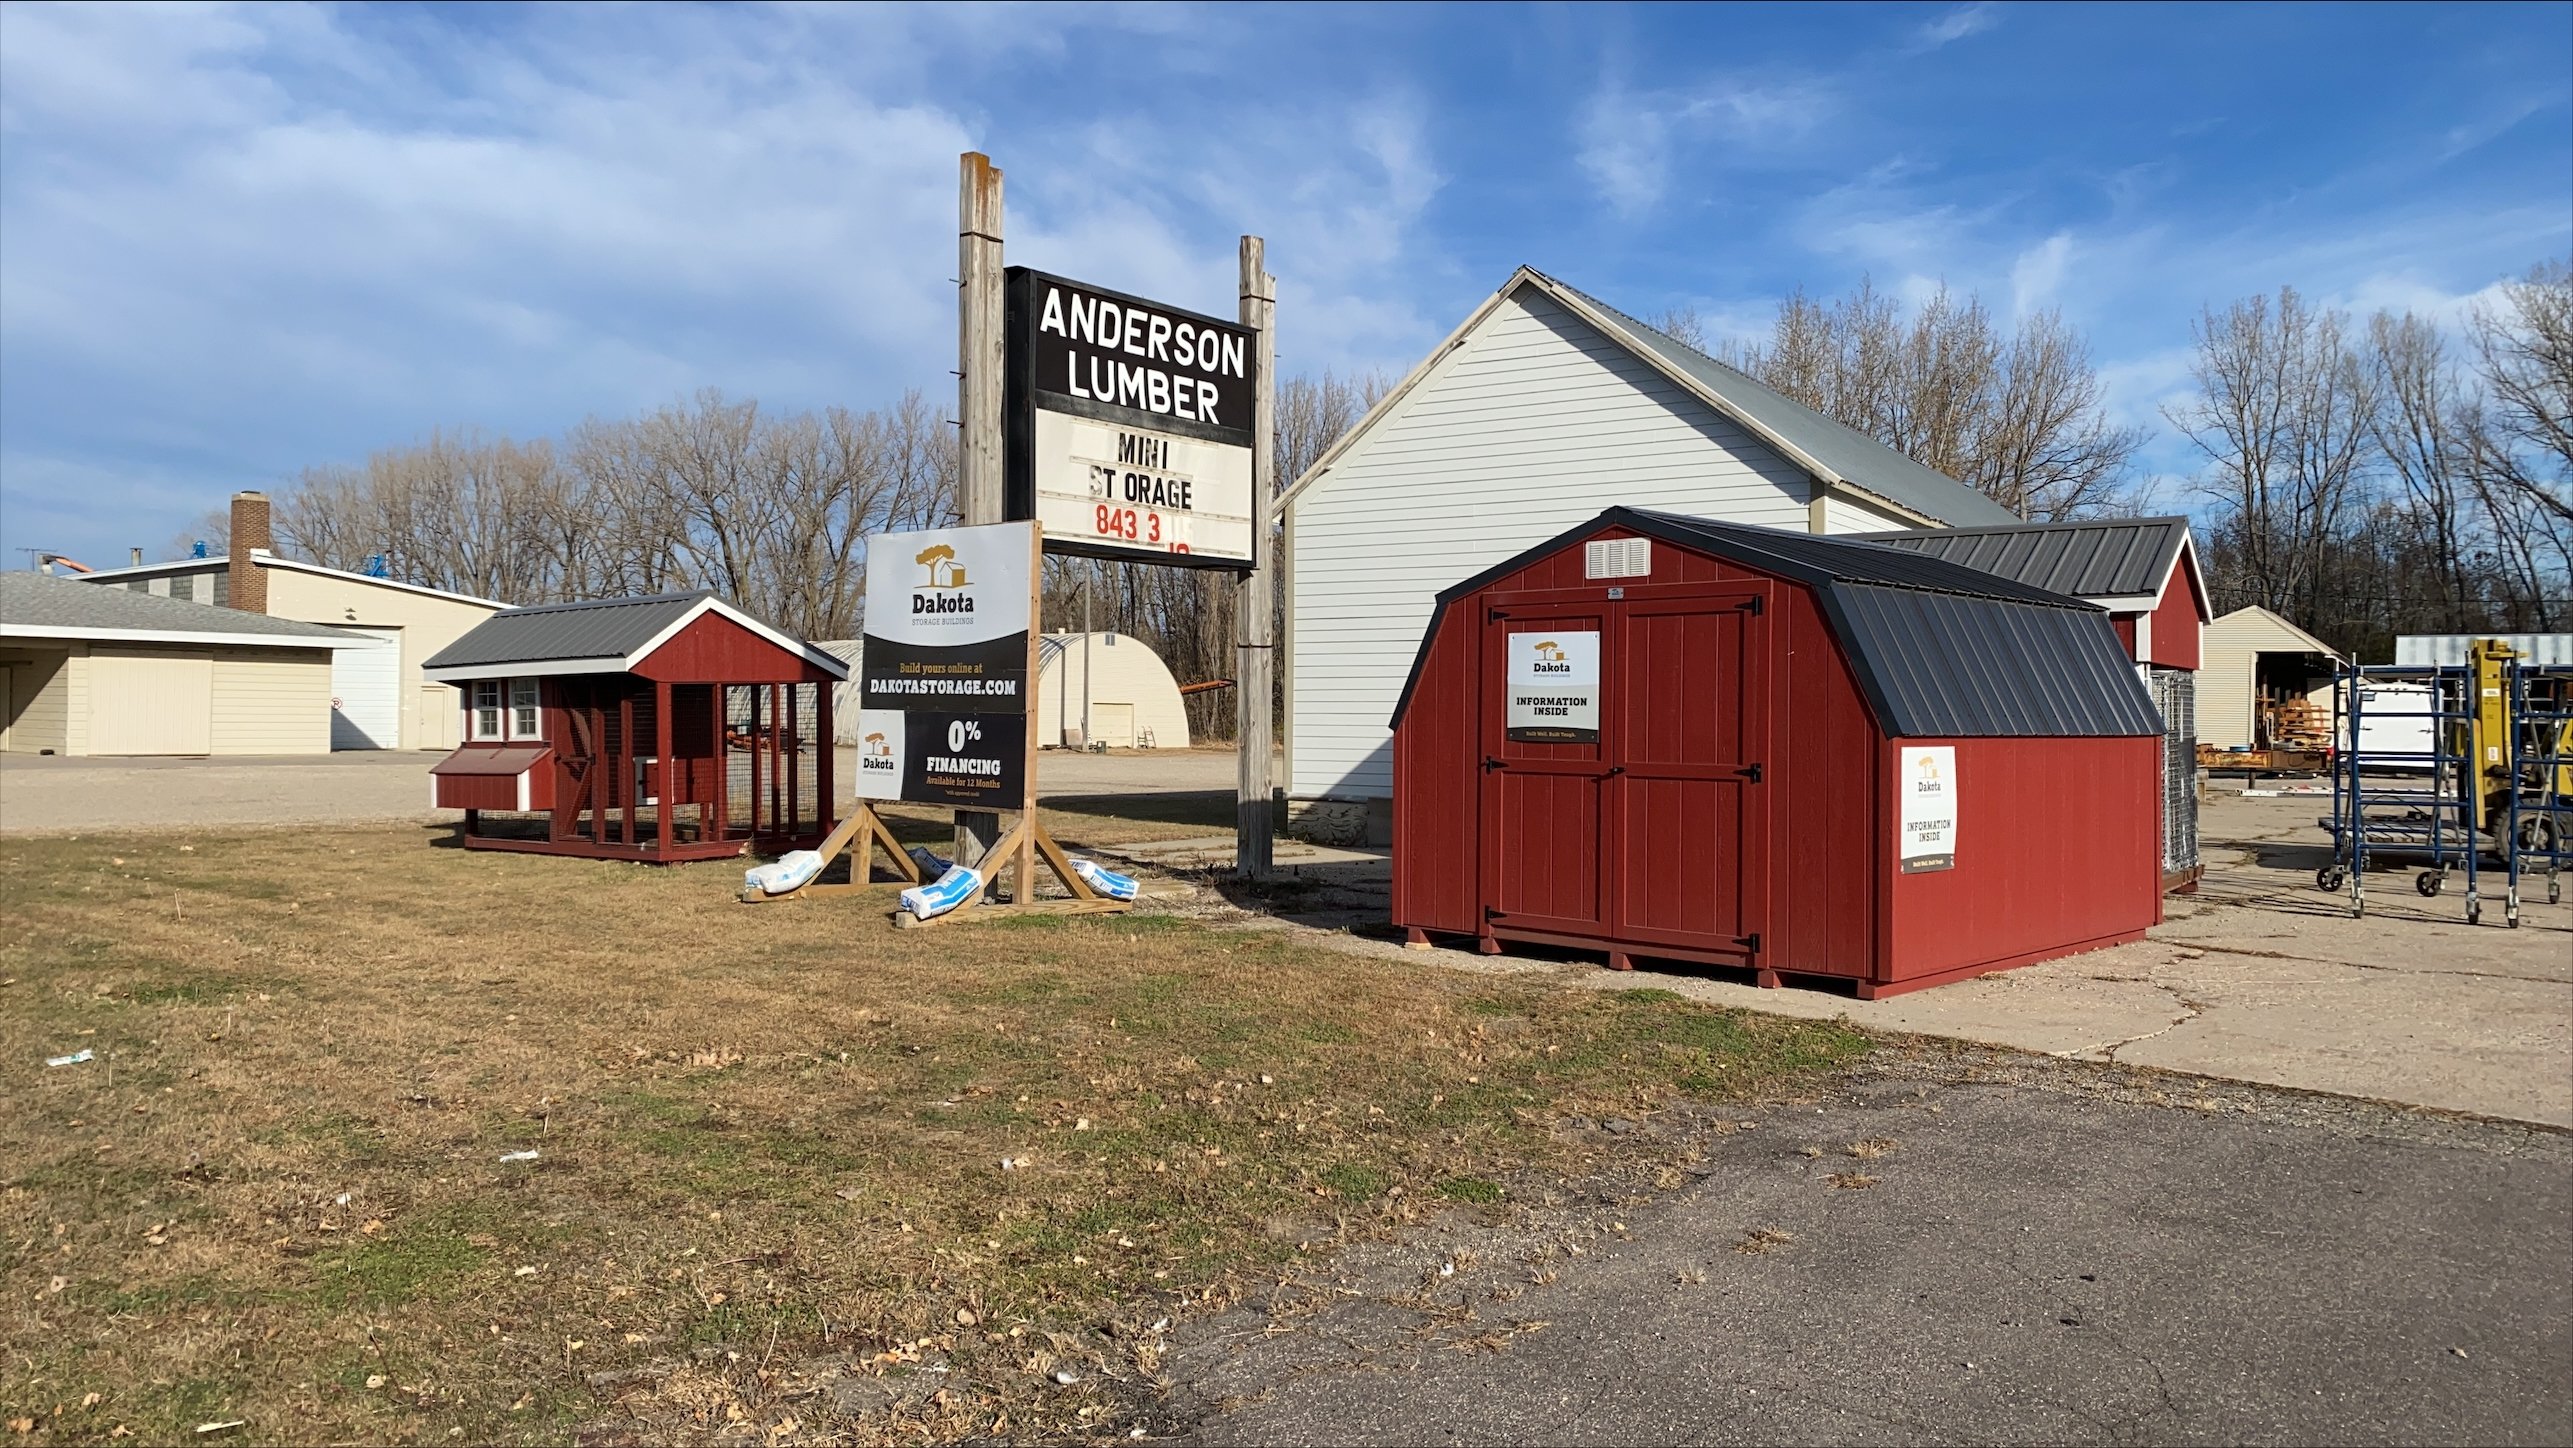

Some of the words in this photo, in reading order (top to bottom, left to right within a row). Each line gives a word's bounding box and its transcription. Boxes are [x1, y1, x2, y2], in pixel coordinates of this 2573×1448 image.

[1040, 287, 1245, 379] ANDERSON
[1068, 350, 1220, 425] LUMBER
[1118, 432, 1168, 469] MINI
[1096, 504, 1138, 539] 843
[912, 592, 974, 614] Dakota
[911, 618, 941, 626] STORAGE
[942, 617, 974, 626] BUILDINGS
[900, 662, 921, 674] Build
[922, 663, 946, 676] yours
[947, 662, 973, 674] online
[974, 662, 983, 674] at
[1533, 662, 1571, 673] Dakota
[870, 679, 1016, 696] DAKOTASTORAGE.COM
[1516, 697, 1588, 706] INFORMATION
[1533, 707, 1569, 716] INSIDE
[947, 720, 982, 753] 0%
[863, 757, 894, 770] Dakota
[926, 756, 1001, 776] FINANCING
[926, 775, 955, 786] Available
[956, 777, 966, 787] for
[966, 778, 975, 787] 12
[975, 778, 1001, 789] Months
[1918, 781, 1942, 792] Dakota
[1907, 819, 1952, 832] INFORMATION
[1919, 831, 1941, 842] INSIDE
